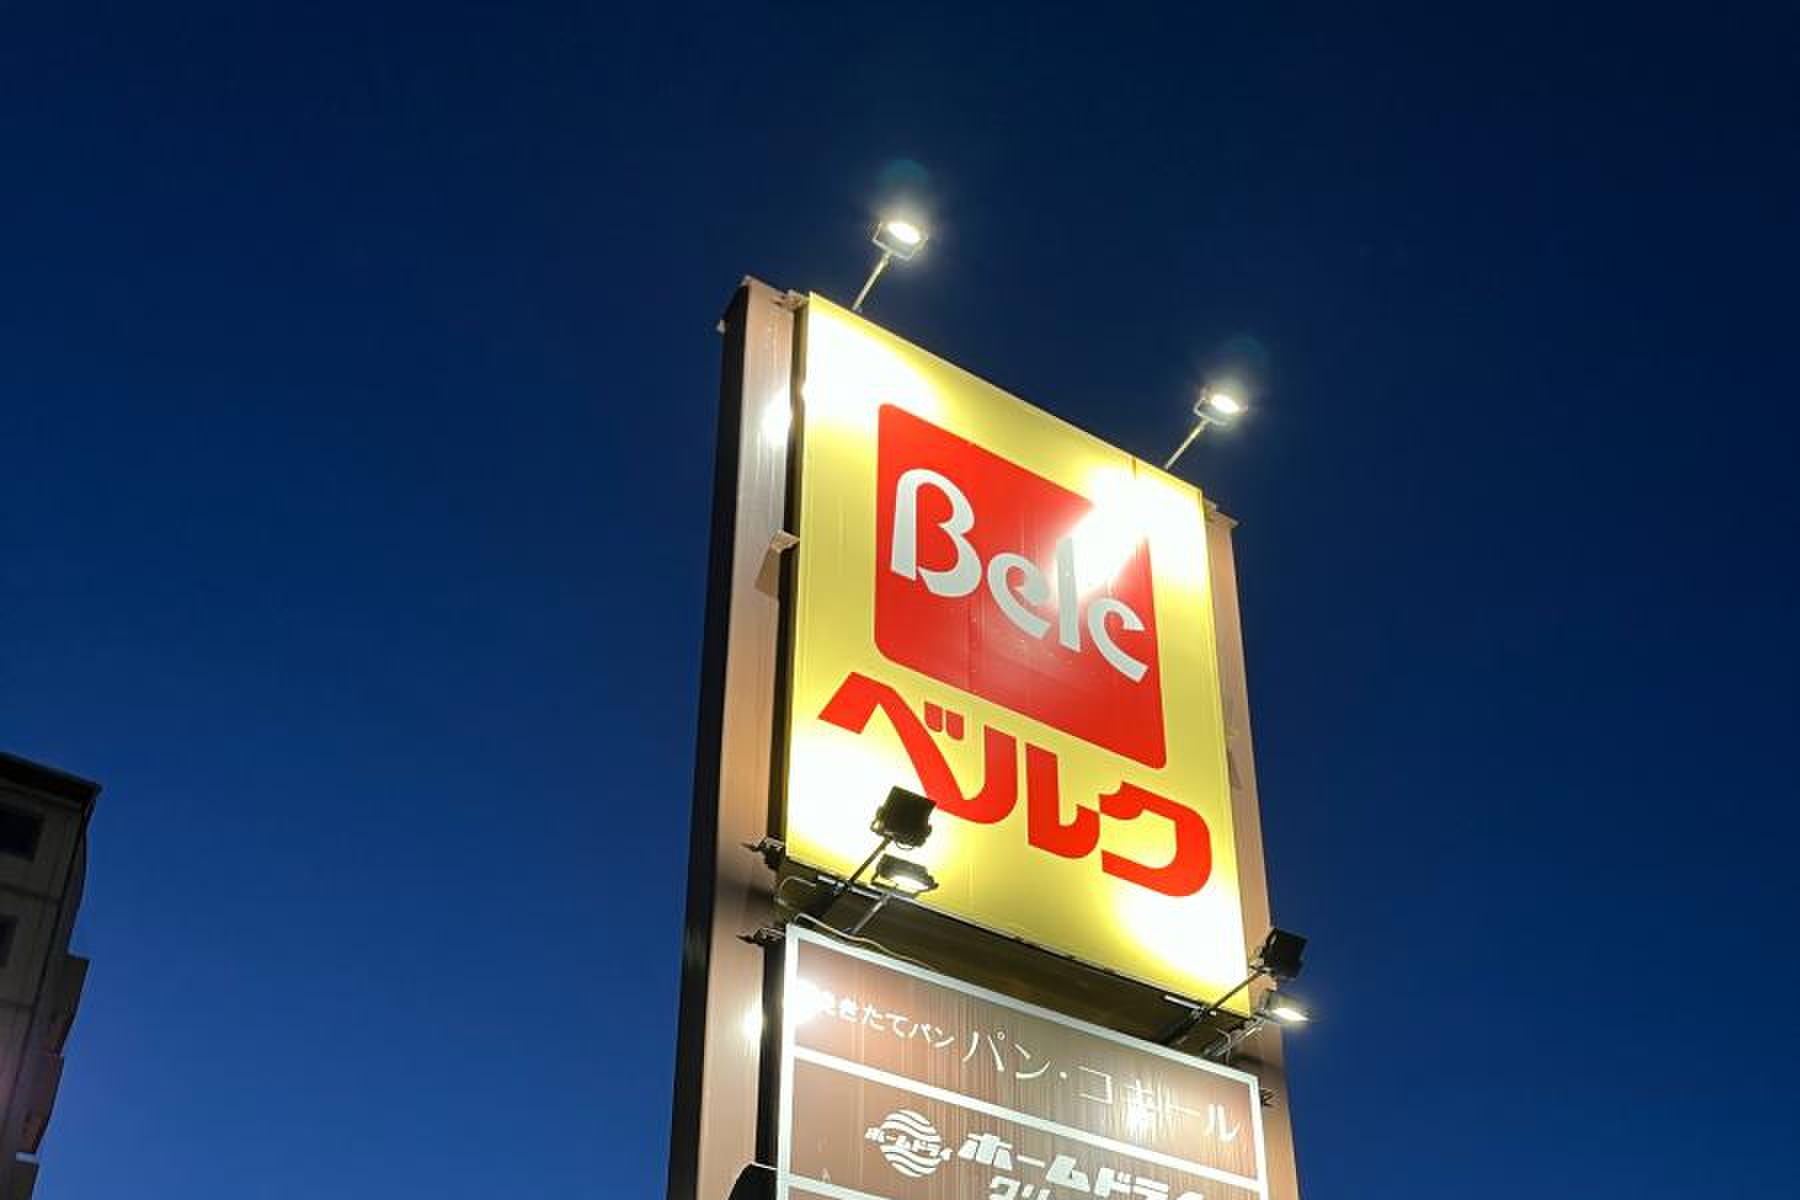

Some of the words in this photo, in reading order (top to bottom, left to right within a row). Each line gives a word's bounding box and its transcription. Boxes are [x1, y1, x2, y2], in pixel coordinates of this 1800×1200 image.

[891, 468, 1147, 683] Belc
[817, 671, 1212, 897] ベルク
[814, 988, 955, 1050] きたてパン
